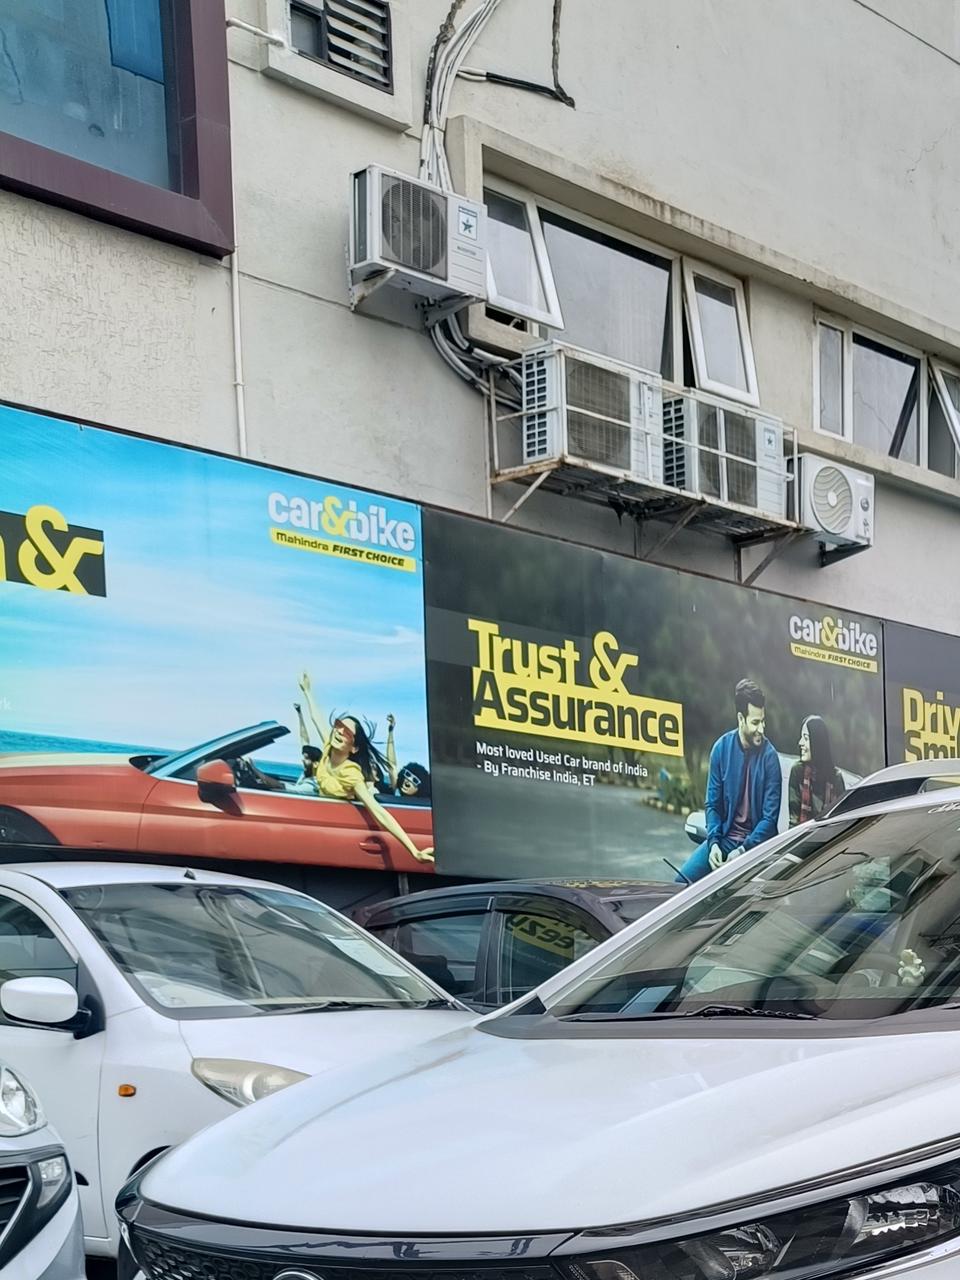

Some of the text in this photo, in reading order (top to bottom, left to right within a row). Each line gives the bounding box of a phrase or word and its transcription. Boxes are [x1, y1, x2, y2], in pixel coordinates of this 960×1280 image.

[268, 491, 415, 551] car&bike
[18, 505, 104, 594] &
[332, 544, 364, 558] FIRST
[366, 551, 405, 567] CHOICE
[468, 618, 638, 694] Trust &
[789, 615, 878, 656] car&bike
[828, 654, 847, 665] FIRST
[848, 658, 871, 669] CHOICE
[473, 669, 680, 747] Assurance
[476, 741, 648, 777] Most loved Used Car brand of India
[484, 760, 499, 776] By
[501, 763, 551, 781] Franchise
[553, 770, 581, 786] India,
[582, 774, 596, 787] ET
